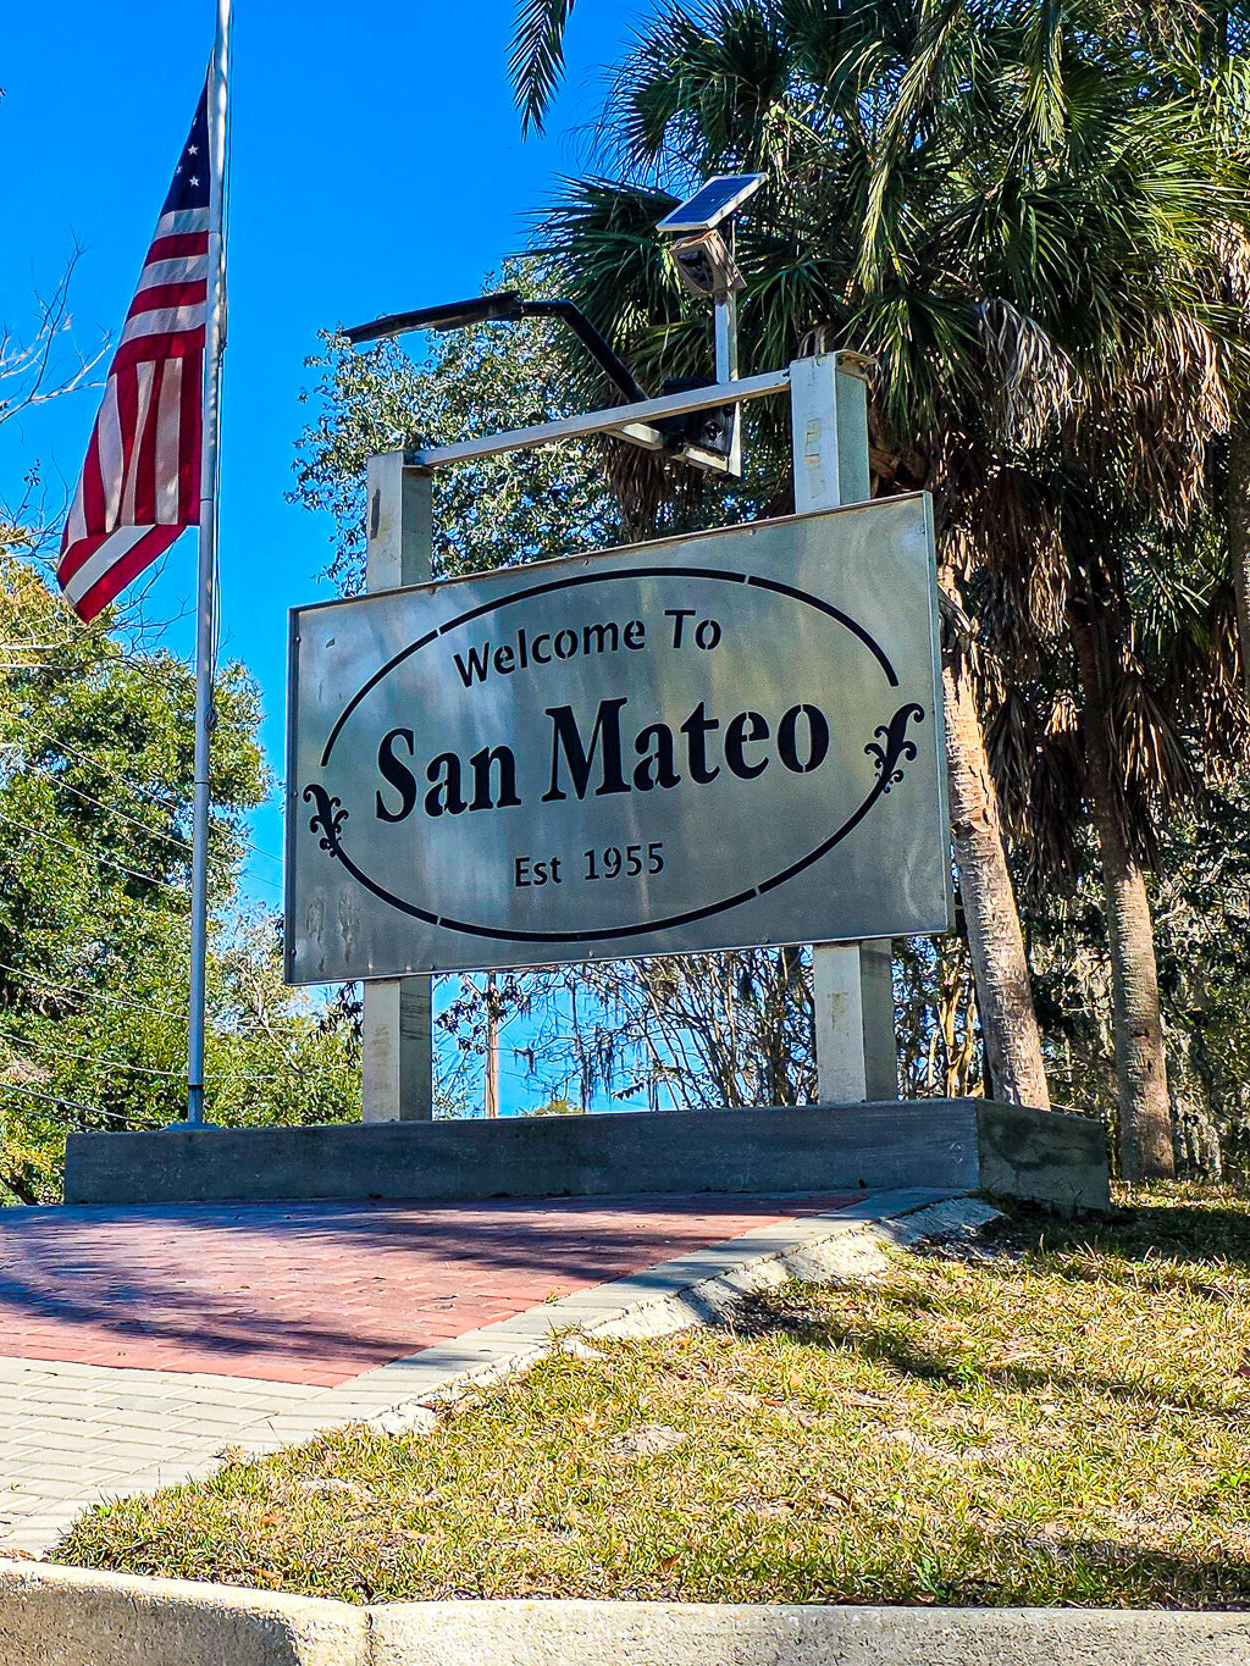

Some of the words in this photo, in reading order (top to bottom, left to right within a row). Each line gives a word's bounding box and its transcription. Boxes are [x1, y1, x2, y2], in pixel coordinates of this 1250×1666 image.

[453, 617, 646, 688] Welcome
[664, 609, 722, 651] To
[375, 727, 522, 823] San
[542, 697, 830, 803] Mateo
[514, 855, 561, 887] Est
[583, 842, 665, 881] 1955
